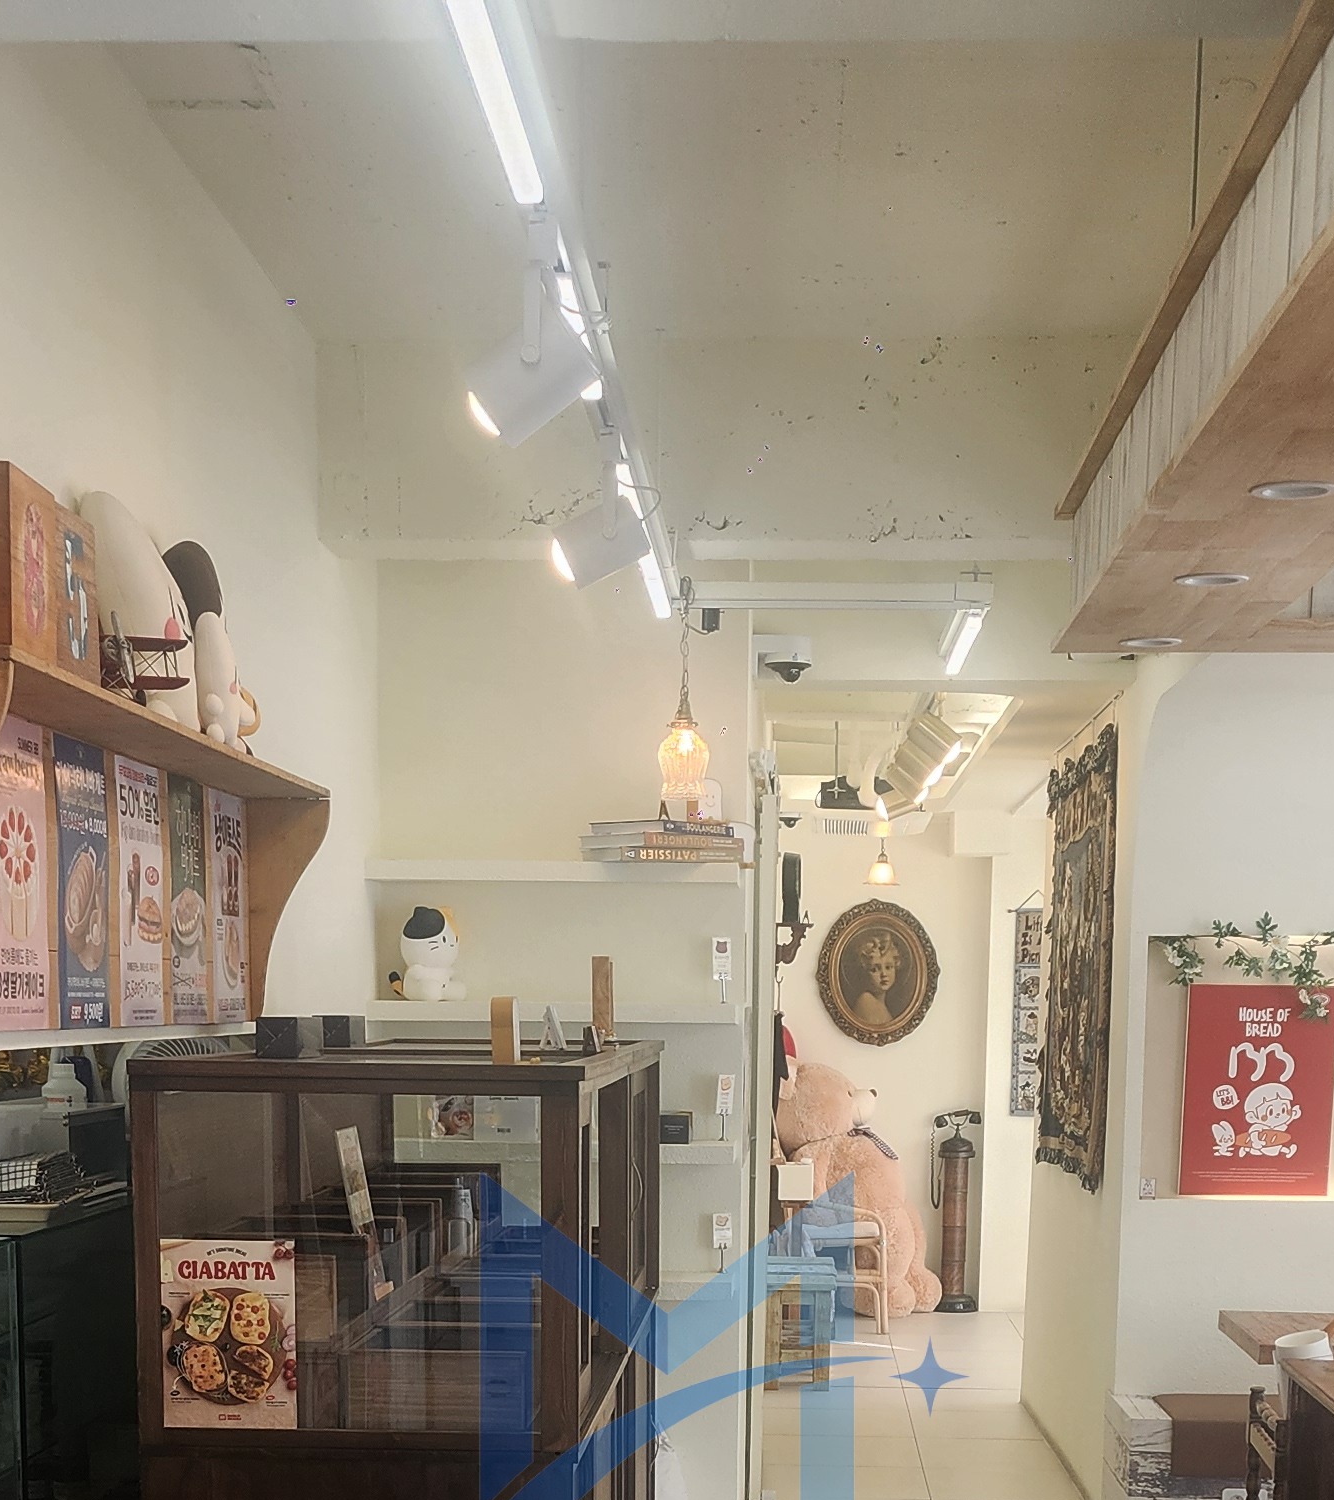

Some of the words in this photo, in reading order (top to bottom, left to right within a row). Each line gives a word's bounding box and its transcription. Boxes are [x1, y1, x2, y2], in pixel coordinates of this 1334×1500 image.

[639, 848, 697, 860] PATISSIER
[1238, 1006, 1274, 1022] HOUSE
[1276, 1007, 1292, 1022] OF
[1245, 1023, 1282, 1038] BREAD
[177, 1260, 276, 1282] CIABATTA
